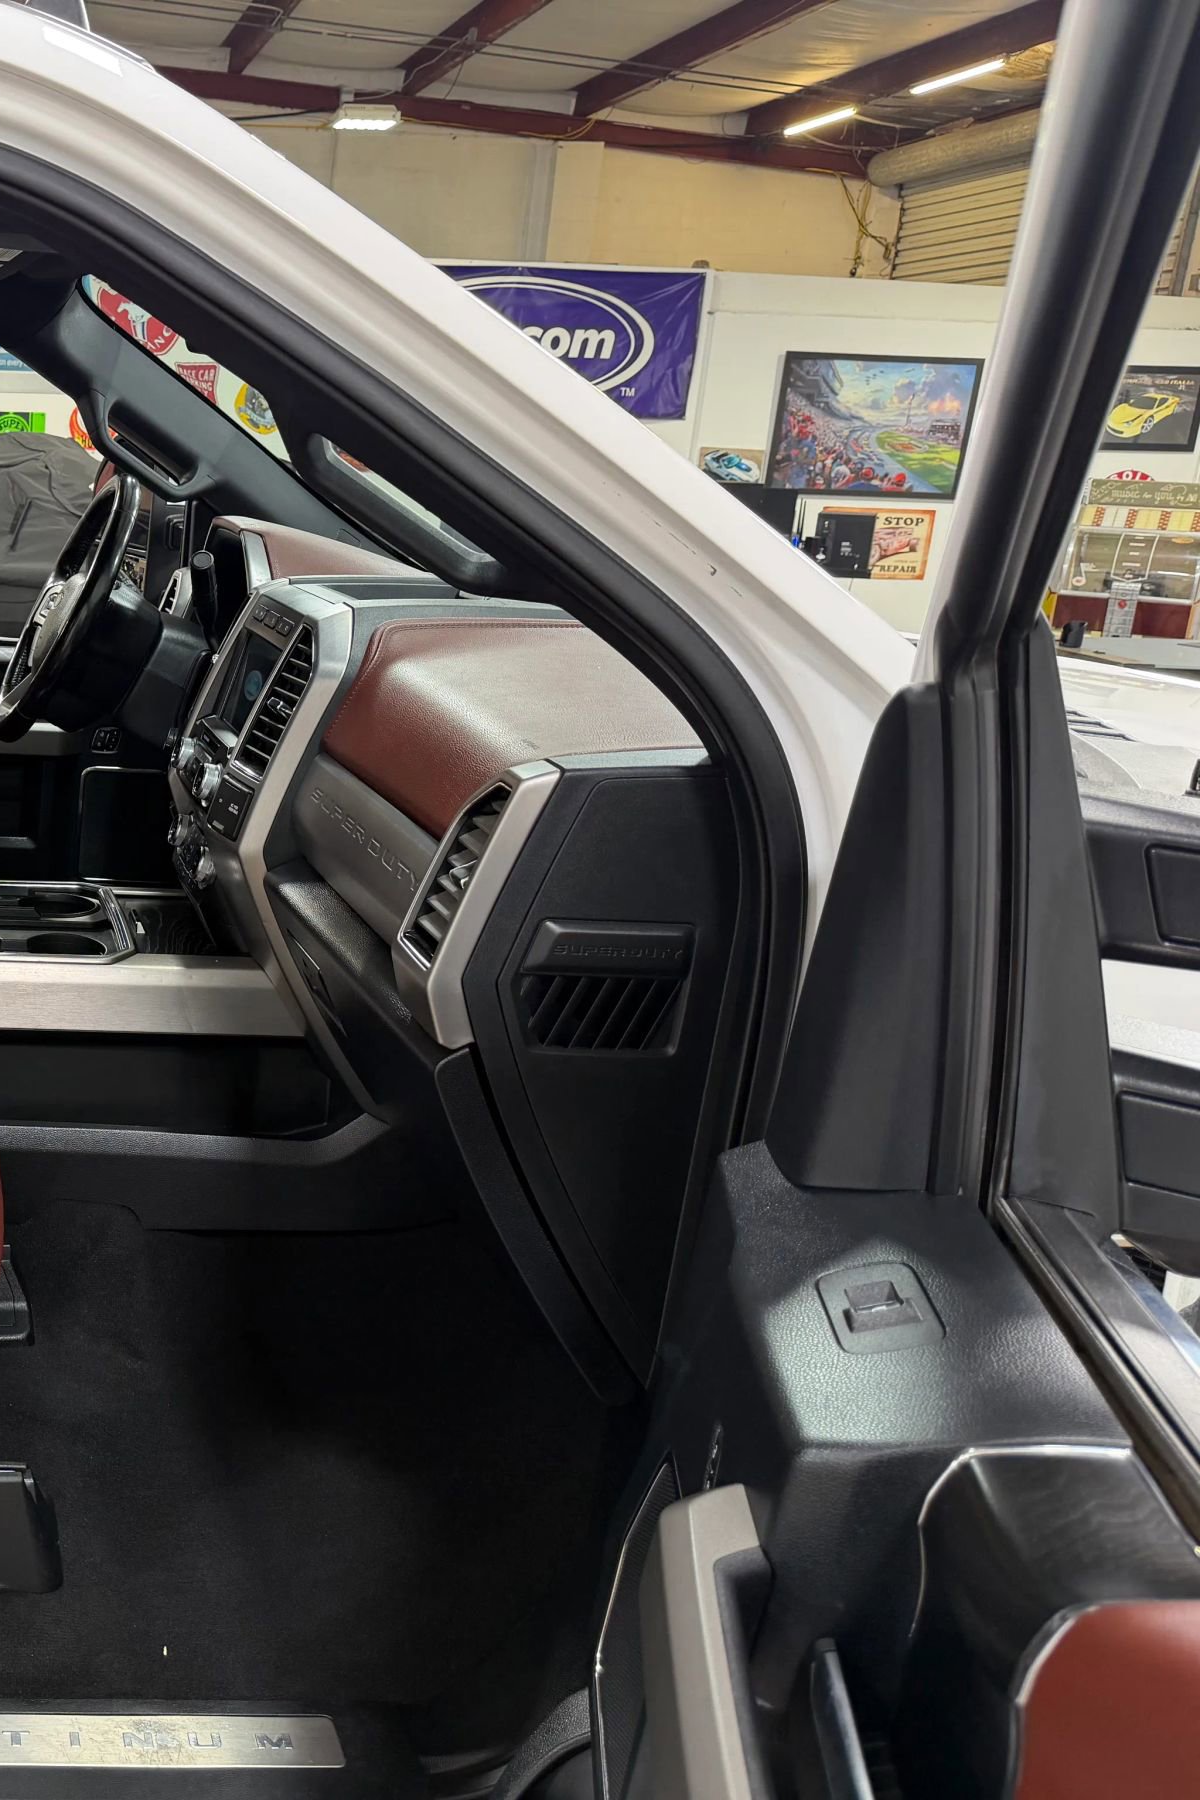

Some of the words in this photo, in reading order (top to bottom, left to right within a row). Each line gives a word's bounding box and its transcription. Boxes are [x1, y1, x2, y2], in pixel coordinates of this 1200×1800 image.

[197, 369, 215, 382] CAR
[883, 516, 925, 527] STOP
[878, 564, 918, 574] REPAIR
[309, 788, 366, 845] SUPER
[367, 837, 419, 892] DUTY
[552, 944, 626, 958] SUPER
[629, 945, 687, 960] DUTY
